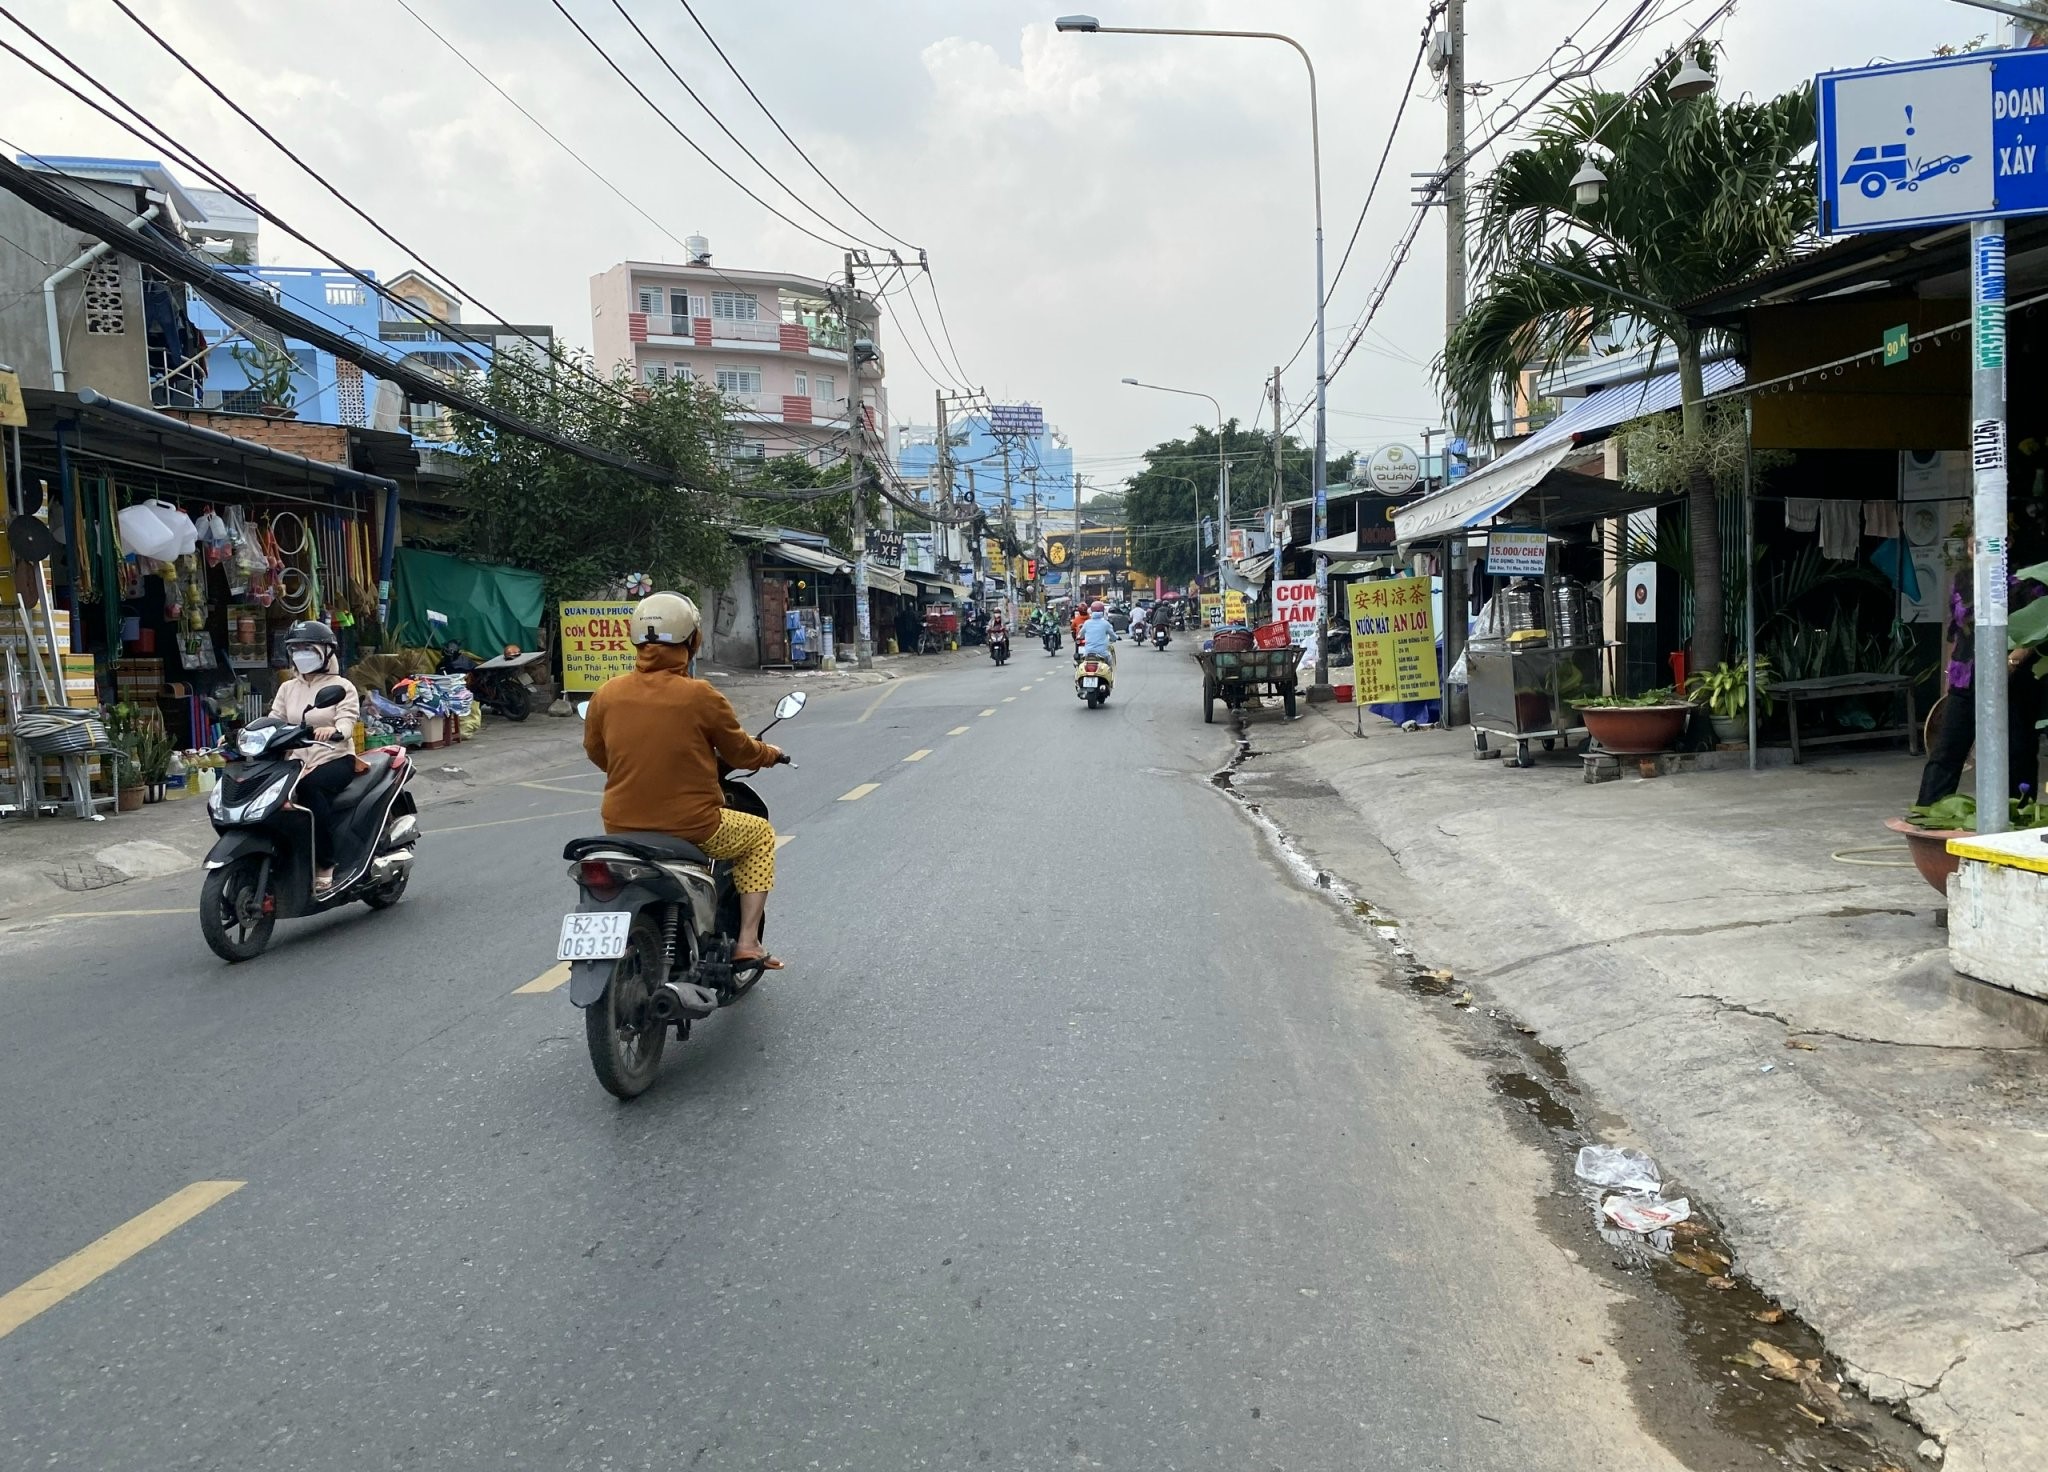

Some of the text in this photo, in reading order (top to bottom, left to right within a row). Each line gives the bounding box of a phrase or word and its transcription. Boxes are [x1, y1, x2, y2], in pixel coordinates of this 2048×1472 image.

[1995, 86, 2045, 124] ĐOẠN
[1999, 133, 2037, 176] XẢY
[1376, 472, 1413, 481] QUÁN
[880, 532, 902, 545] DÁN
[882, 546, 898, 556] XE
[1490, 545, 1545, 557] 15.000/CHÉN
[1354, 584, 1426, 610] 安利涼茶
[565, 619, 632, 638] CƠM CHAY
[1355, 613, 1374, 636] NƯỚC
[1393, 613, 1408, 632] AN
[1410, 608, 1428, 634] LỢI
[574, 640, 629, 651] 15K
[563, 936, 623, 957] 063.50
